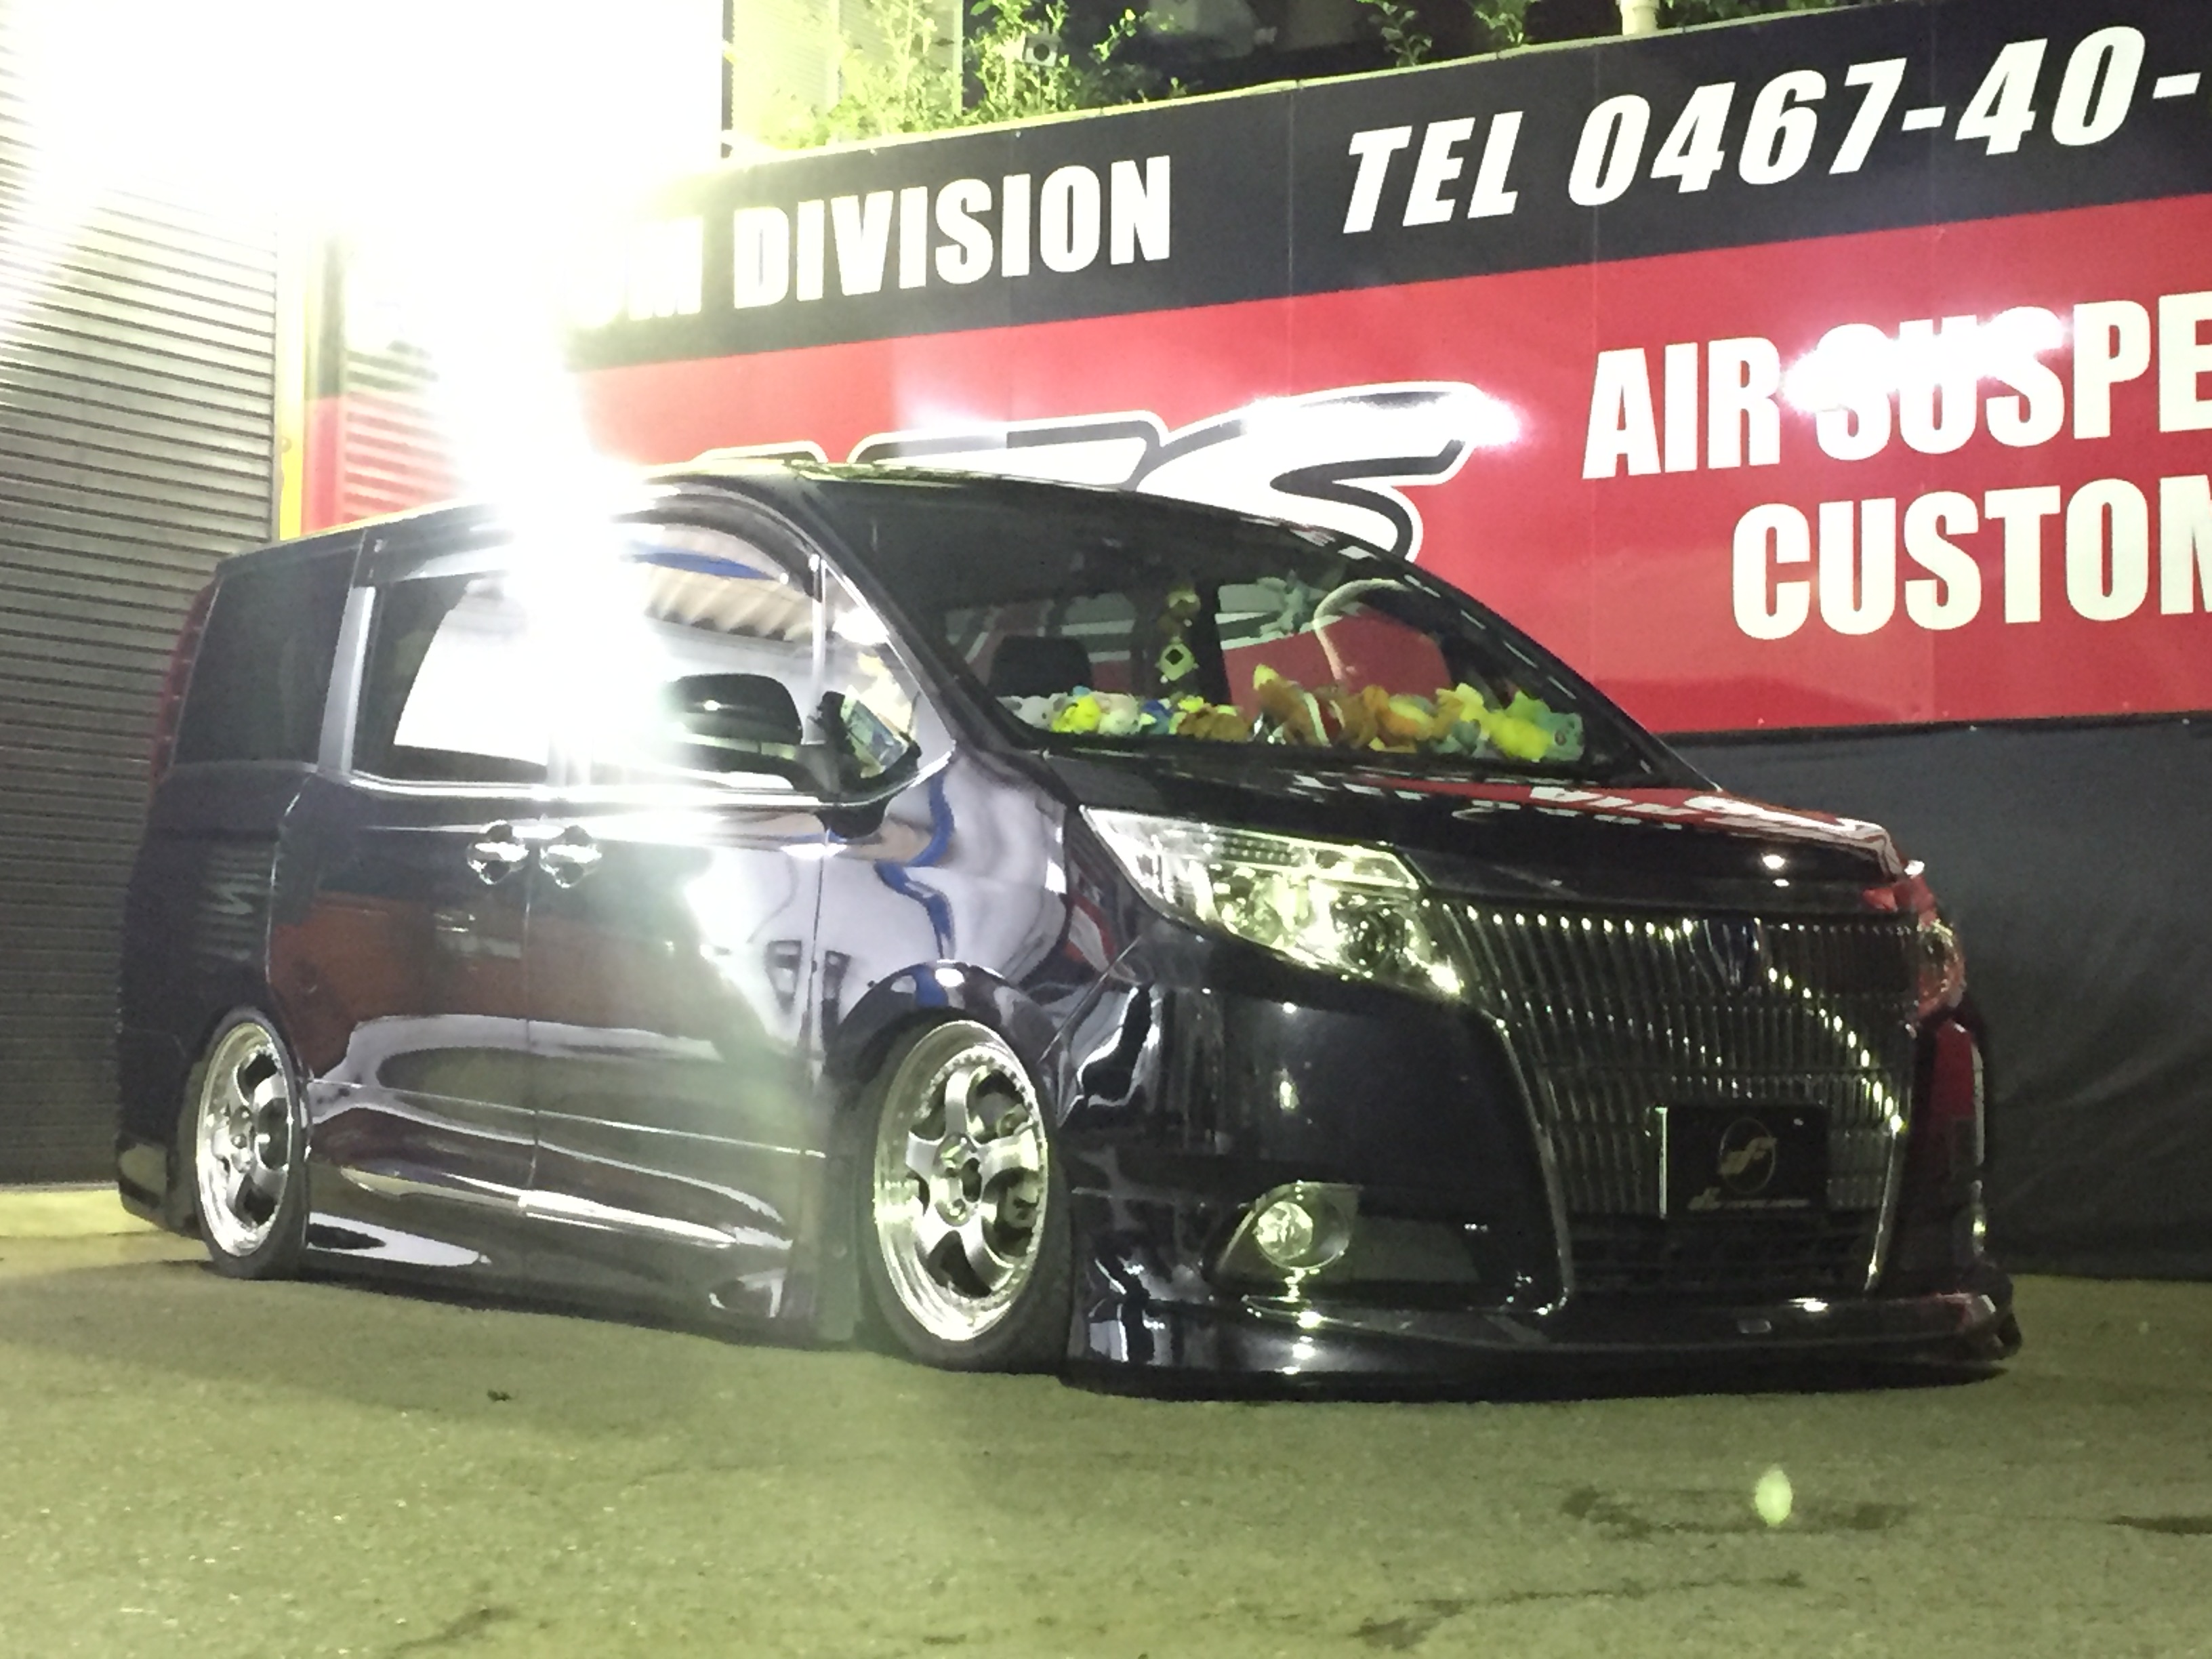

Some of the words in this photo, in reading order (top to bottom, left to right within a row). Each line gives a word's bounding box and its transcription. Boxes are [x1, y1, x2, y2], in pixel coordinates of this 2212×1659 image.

[1343, 111, 1522, 233] TEL
[1567, 26, 2200, 206] 0467-40-
[733, 155, 1170, 309] DIVISION
[1582, 337, 1780, 479] AIR
